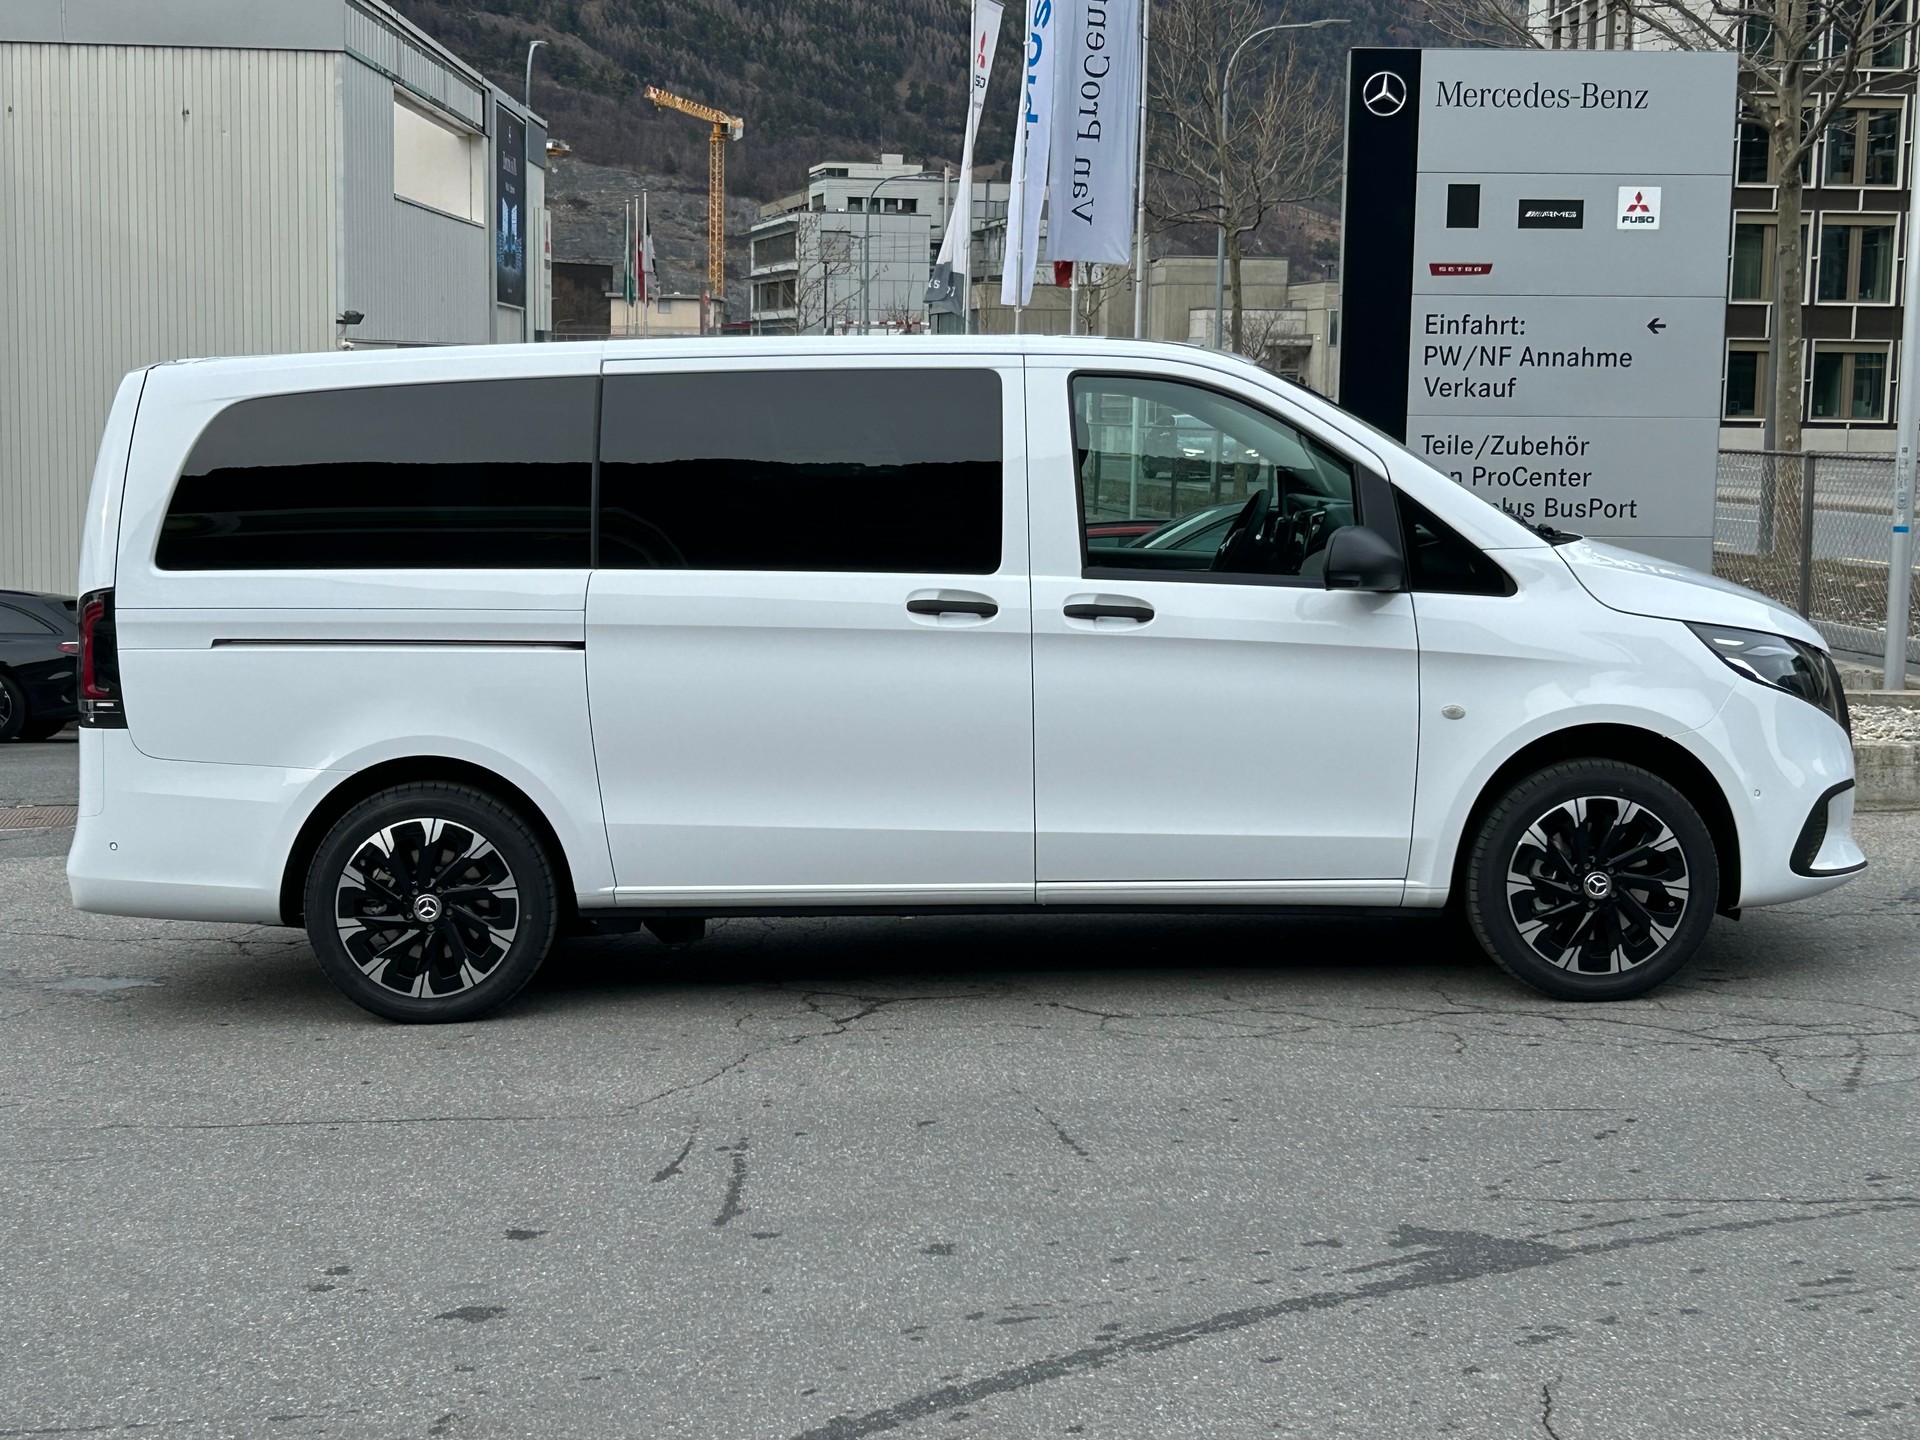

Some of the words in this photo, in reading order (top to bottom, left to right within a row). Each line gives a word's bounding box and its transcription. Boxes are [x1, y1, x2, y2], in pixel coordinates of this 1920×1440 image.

[1435, 80, 1650, 110] Mercedes-Benz
[1621, 215, 1656, 224] FUSO
[1425, 313, 1526, 336] Einfahrt:
[1423, 345, 1512, 372] PW/NF
[1519, 346, 1633, 368] Annahme
[1424, 376, 1518, 398] Verkauf
[1421, 434, 1591, 461] Teile/Zubehör
[1472, 466, 1593, 488] ProCenter
[1544, 497, 1638, 519] BusPort
